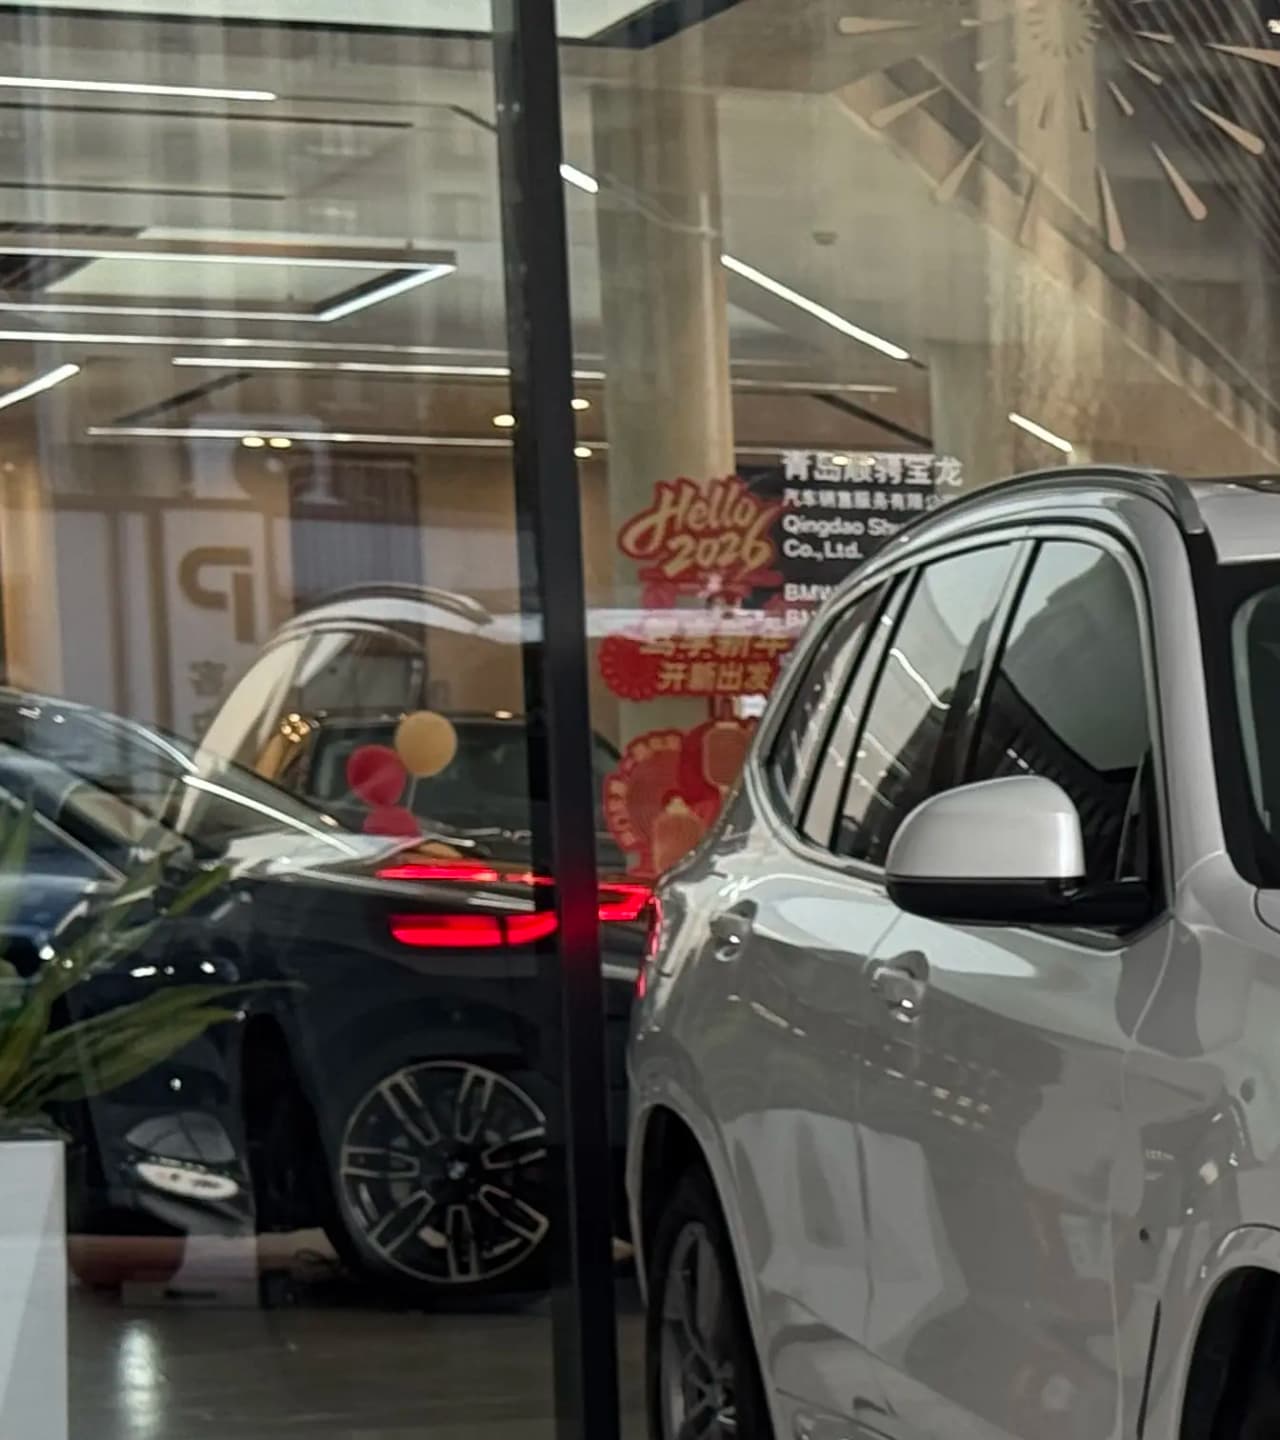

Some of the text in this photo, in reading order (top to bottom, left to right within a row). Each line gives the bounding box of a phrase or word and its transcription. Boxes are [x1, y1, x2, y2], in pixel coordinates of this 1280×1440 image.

[622, 480, 757, 557] Hello
[663, 503, 783, 580] 2026
[782, 514, 865, 538] Qingdao
